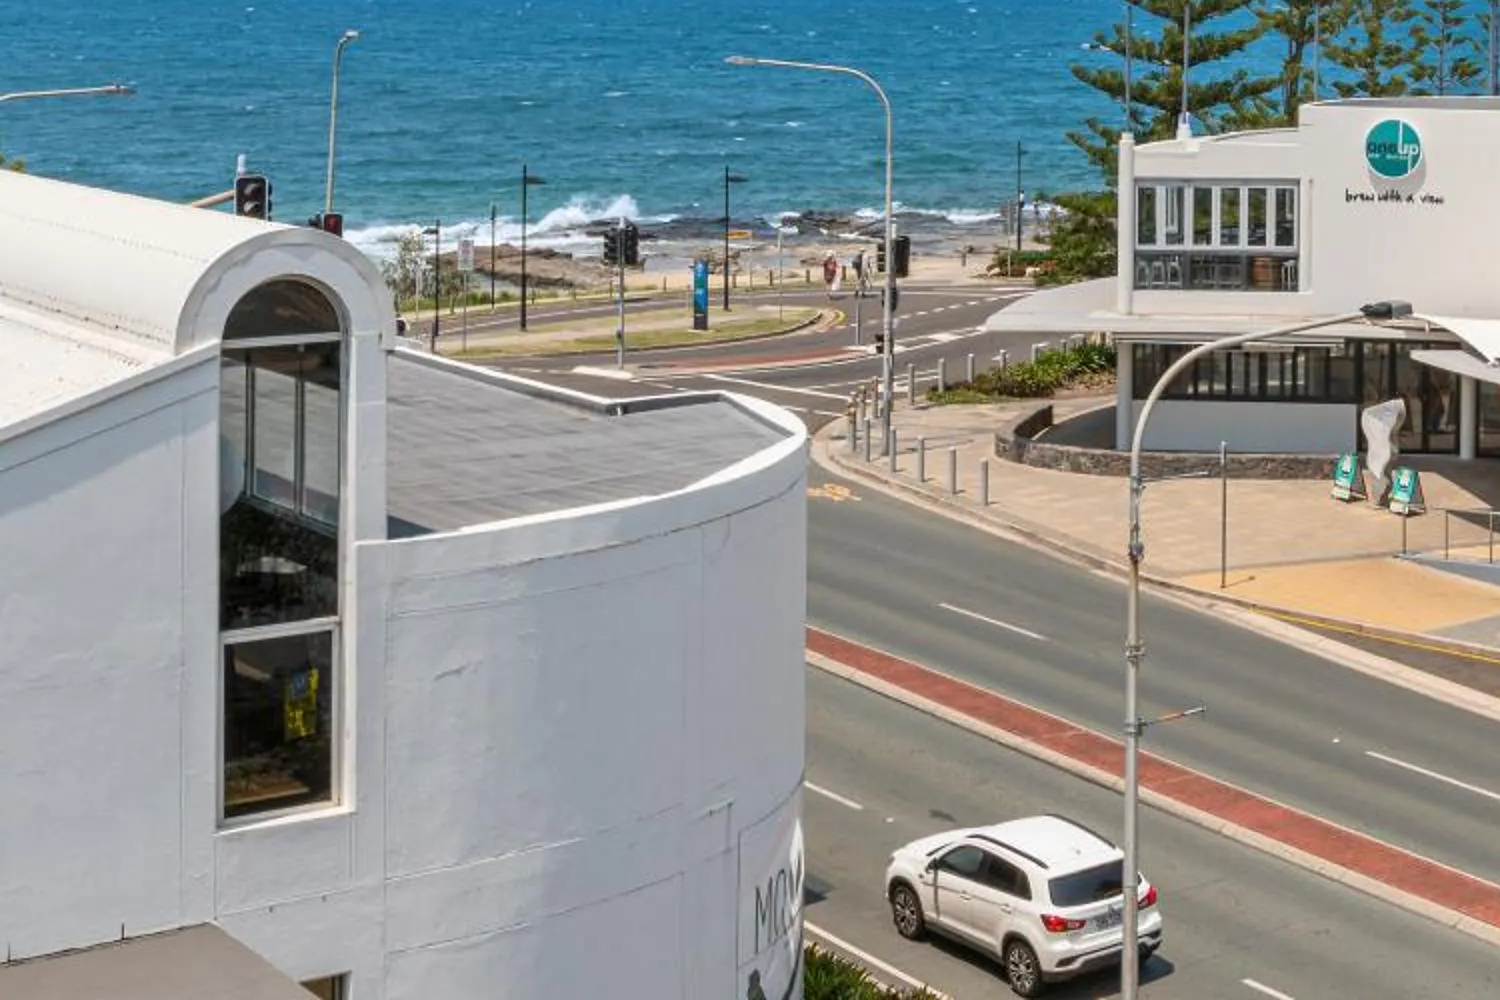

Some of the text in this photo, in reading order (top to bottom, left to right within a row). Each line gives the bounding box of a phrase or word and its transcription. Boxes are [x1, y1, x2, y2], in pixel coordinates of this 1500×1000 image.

[1345, 188, 1444, 204] brew with a view
